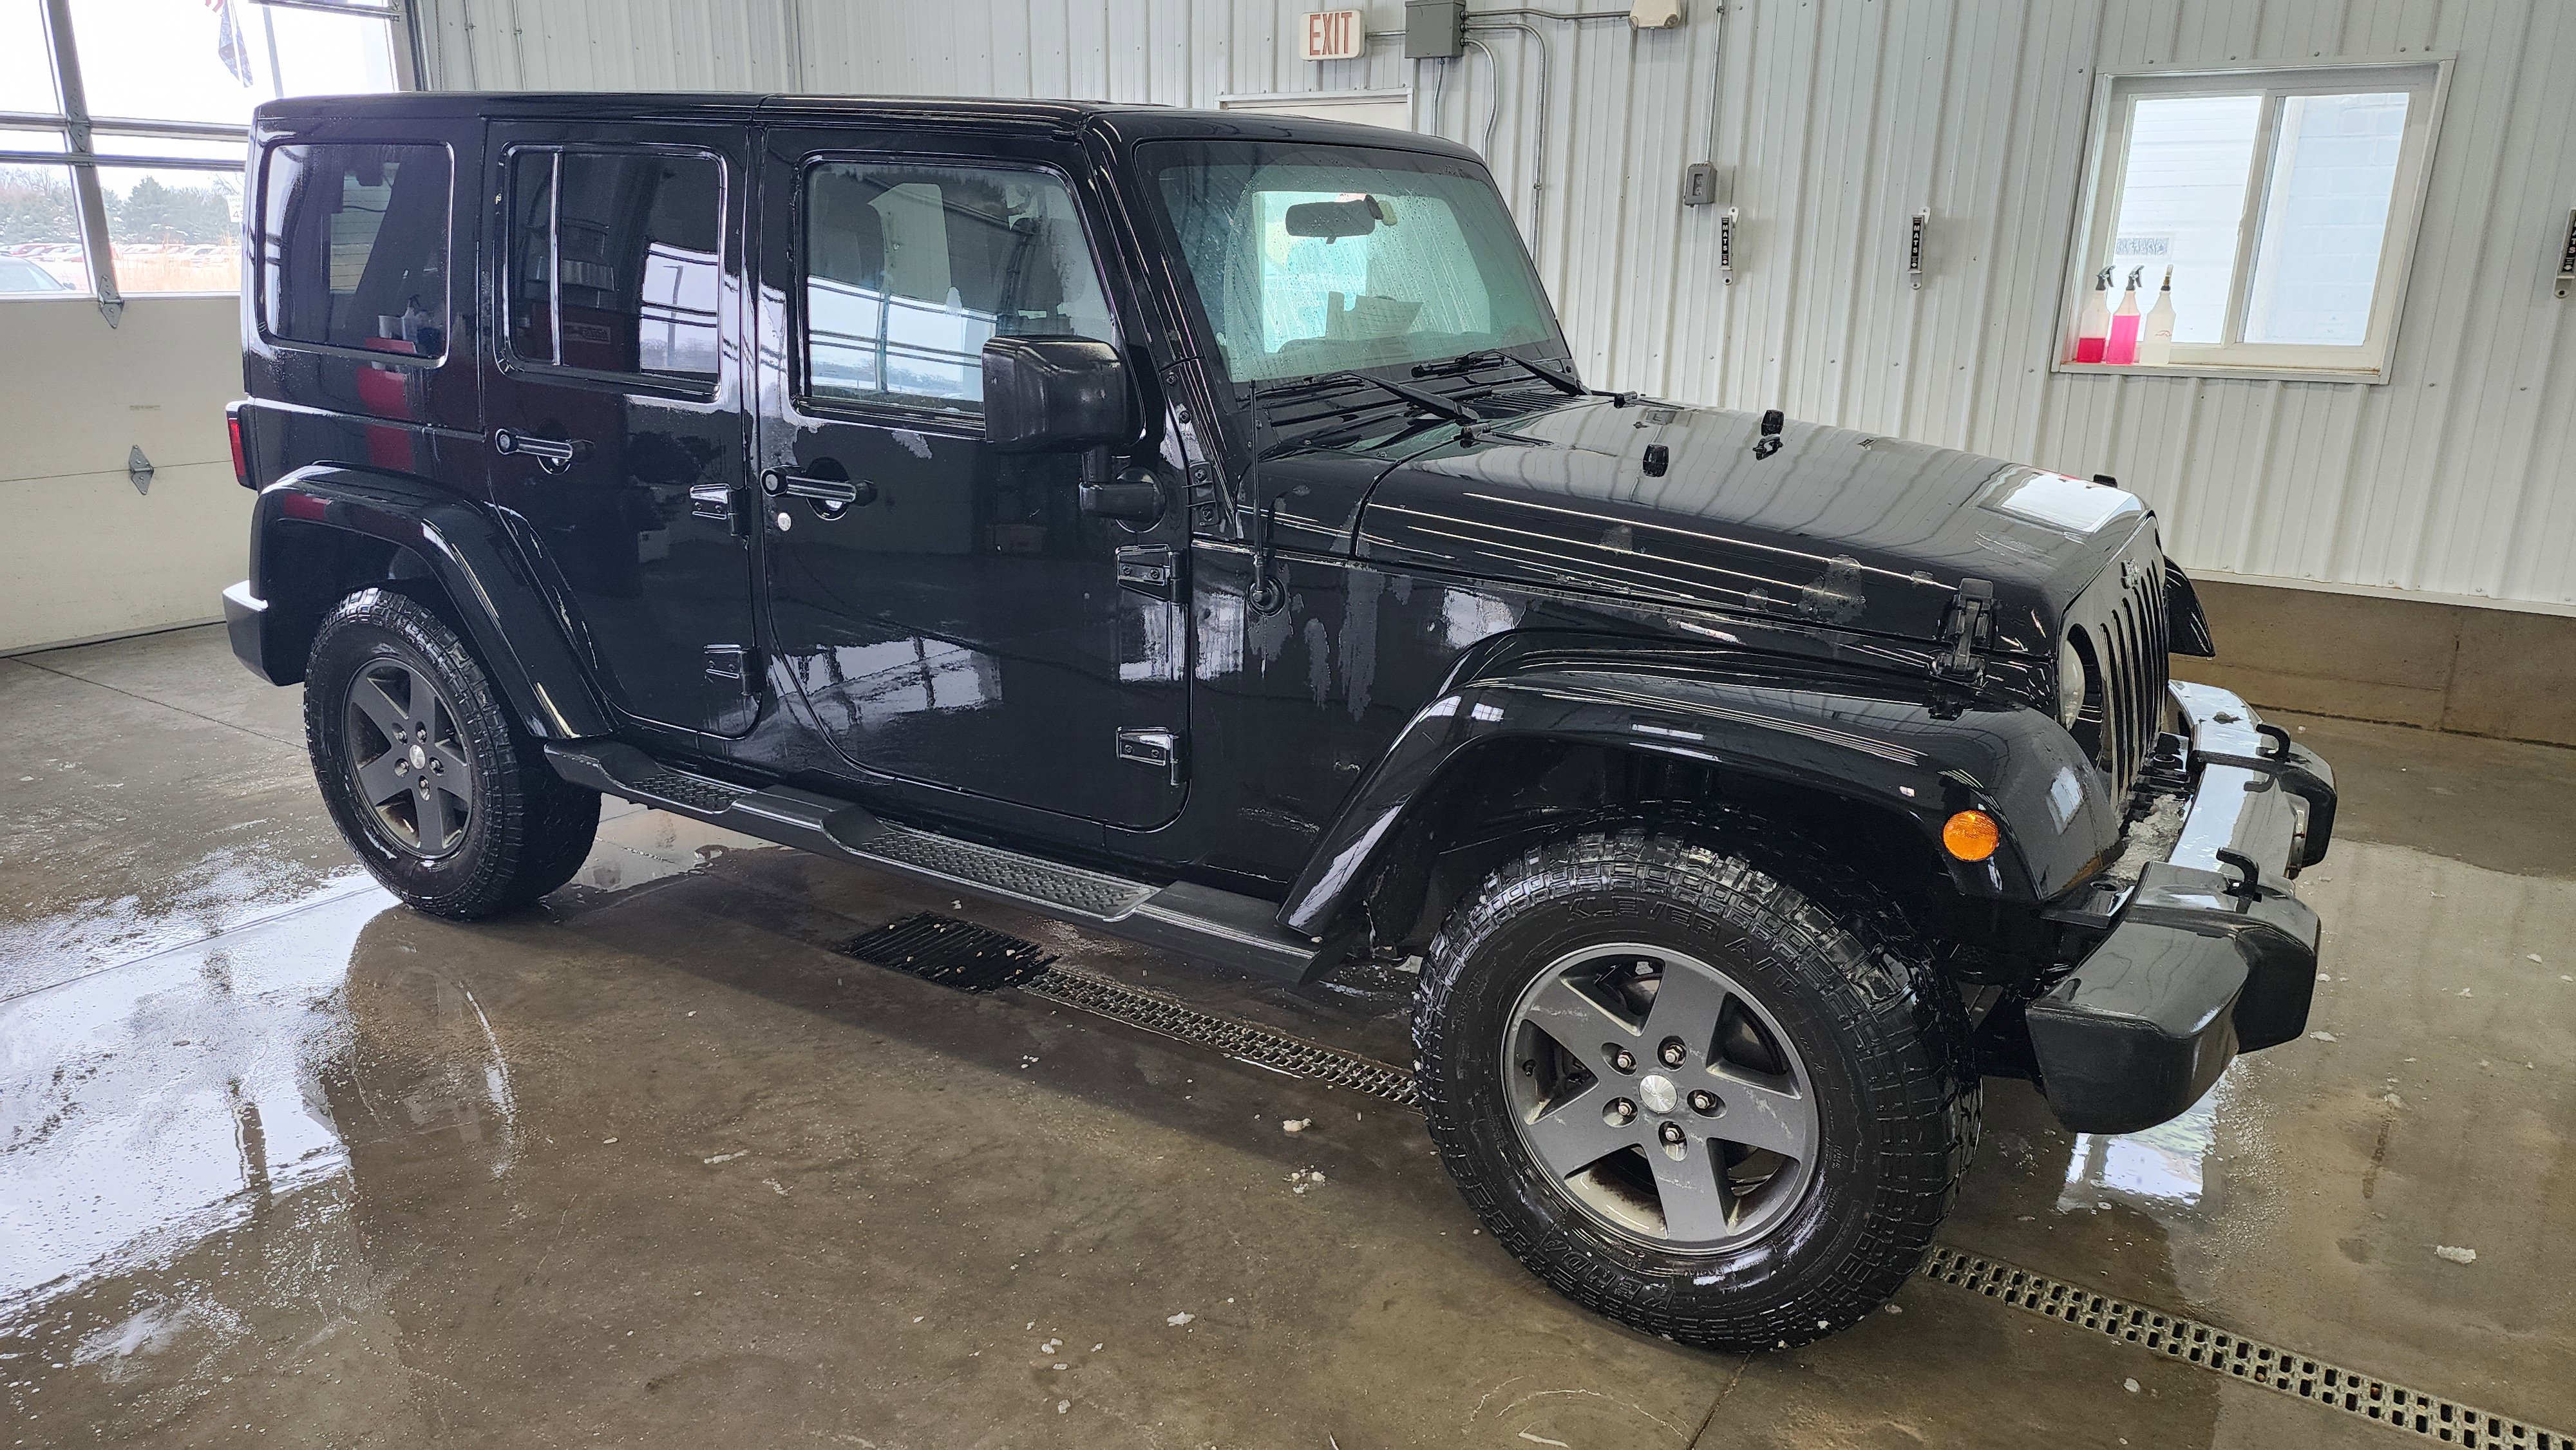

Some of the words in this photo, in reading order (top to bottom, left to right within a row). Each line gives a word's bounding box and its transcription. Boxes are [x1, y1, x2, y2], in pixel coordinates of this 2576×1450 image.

[1309, 12, 1352, 55] EXIT
[1912, 225, 1920, 254] MATS
[1539, 1230, 1676, 1311] KENDA
